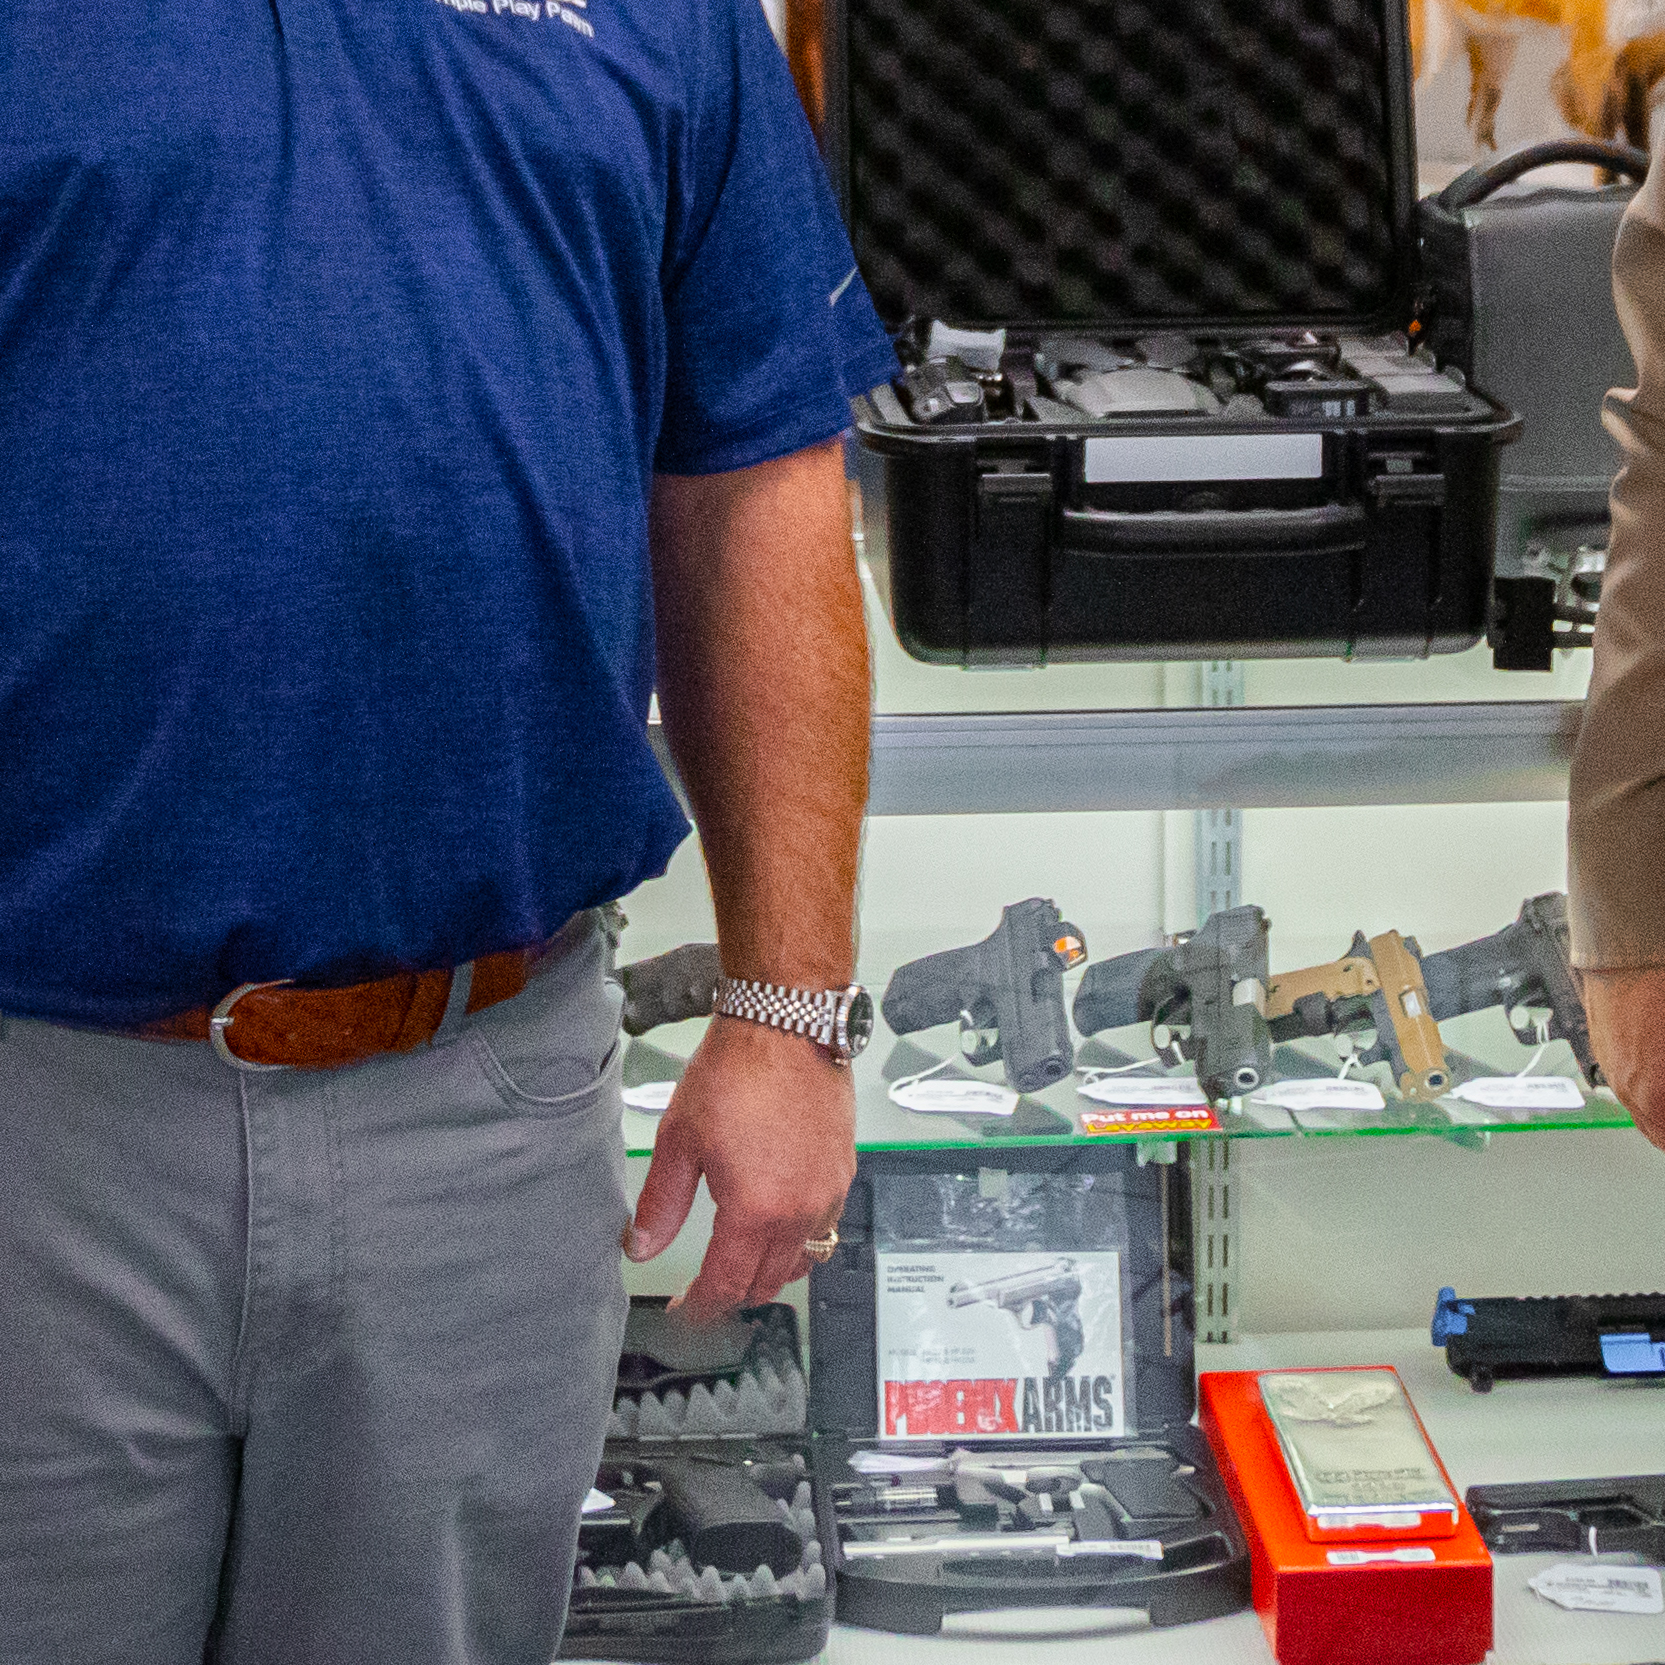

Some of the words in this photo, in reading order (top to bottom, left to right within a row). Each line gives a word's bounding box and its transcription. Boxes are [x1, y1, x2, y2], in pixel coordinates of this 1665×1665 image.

[545, 0, 595, 38] Pawn
[1082, 1113, 1126, 1123] Put
[1131, 1111, 1170, 1121] me
[1174, 1109, 1209, 1119] on
[1087, 1119, 1212, 1133] Layaway
[1022, 1375, 1113, 1433] ARMS
